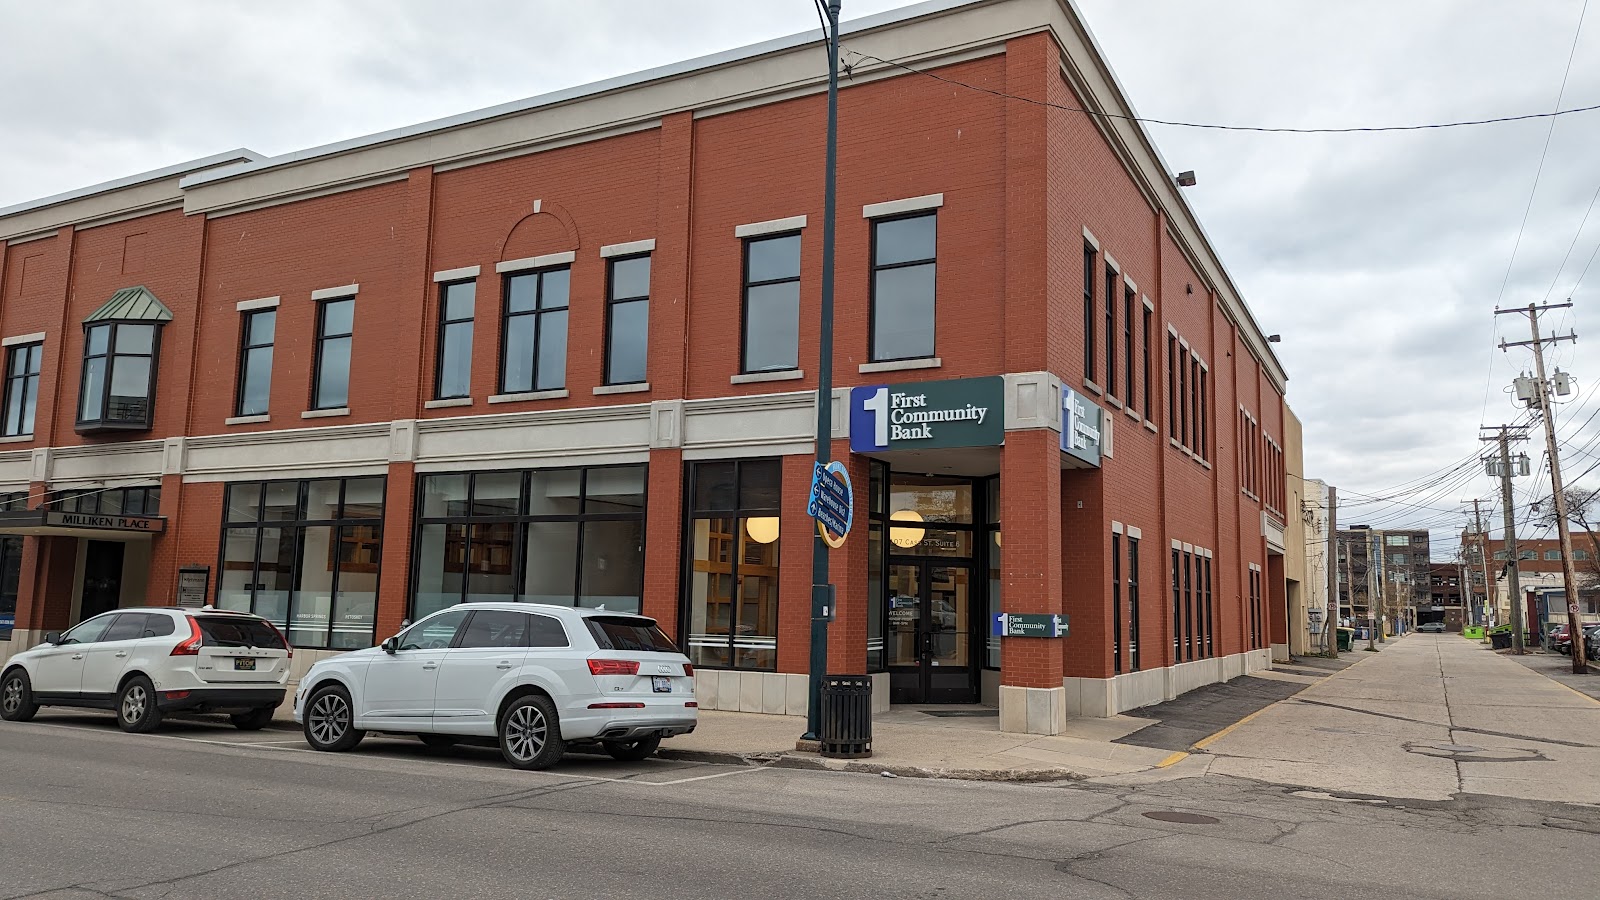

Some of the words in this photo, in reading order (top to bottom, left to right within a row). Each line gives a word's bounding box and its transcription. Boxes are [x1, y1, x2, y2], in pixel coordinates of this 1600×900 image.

[863, 387, 889, 447] 1
[890, 392, 927, 409] First
[890, 403, 988, 425] Community
[1074, 398, 1086, 418] First
[890, 423, 933, 441] Bank
[1074, 415, 1101, 447] Community
[1074, 430, 1087, 450] Bank
[822, 471, 833, 487] Opera
[820, 489, 839, 512] Warehouse
[62, 514, 113, 527] MILLIKEN
[118, 518, 150, 529] PLACE
[935, 540, 954, 548] SUITE
[998, 612, 1008, 636] 1
[1008, 622, 1046, 631] Community
